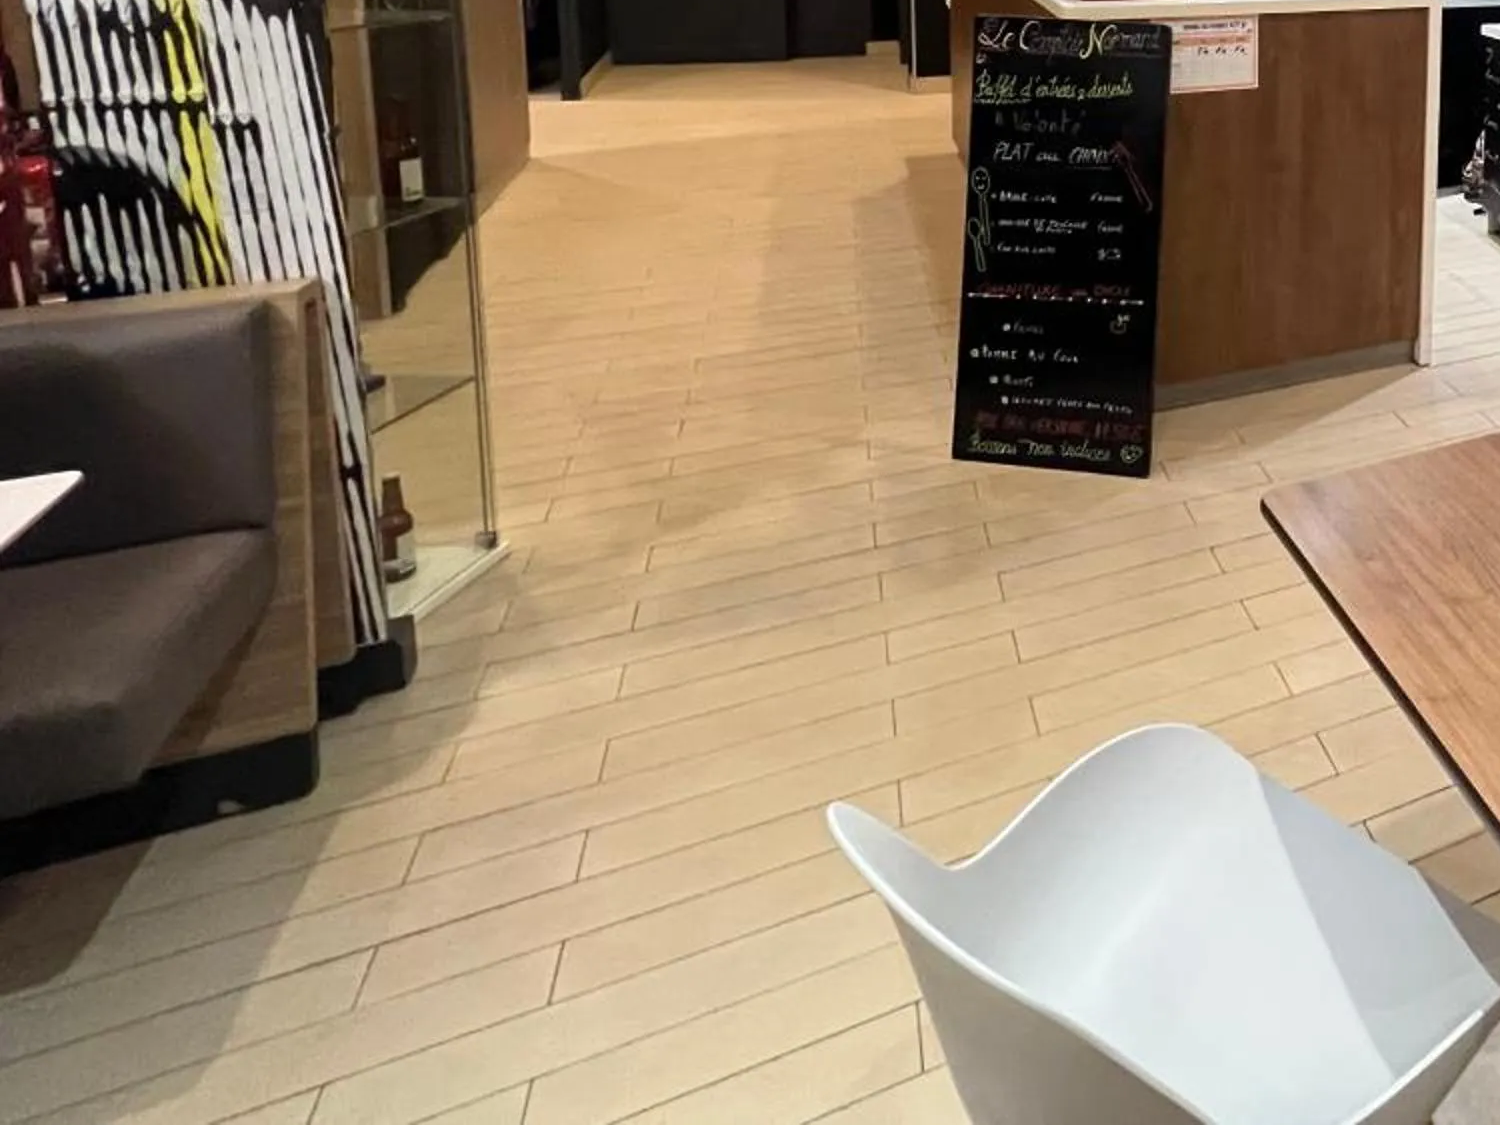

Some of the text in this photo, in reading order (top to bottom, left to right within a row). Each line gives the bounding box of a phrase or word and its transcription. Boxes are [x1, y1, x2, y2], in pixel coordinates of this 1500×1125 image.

[978, 20, 1014, 50] Le
[976, 70, 1017, 100] Buffet
[1087, 72, 1133, 99] desserts
[993, 140, 1034, 163] PLAT
